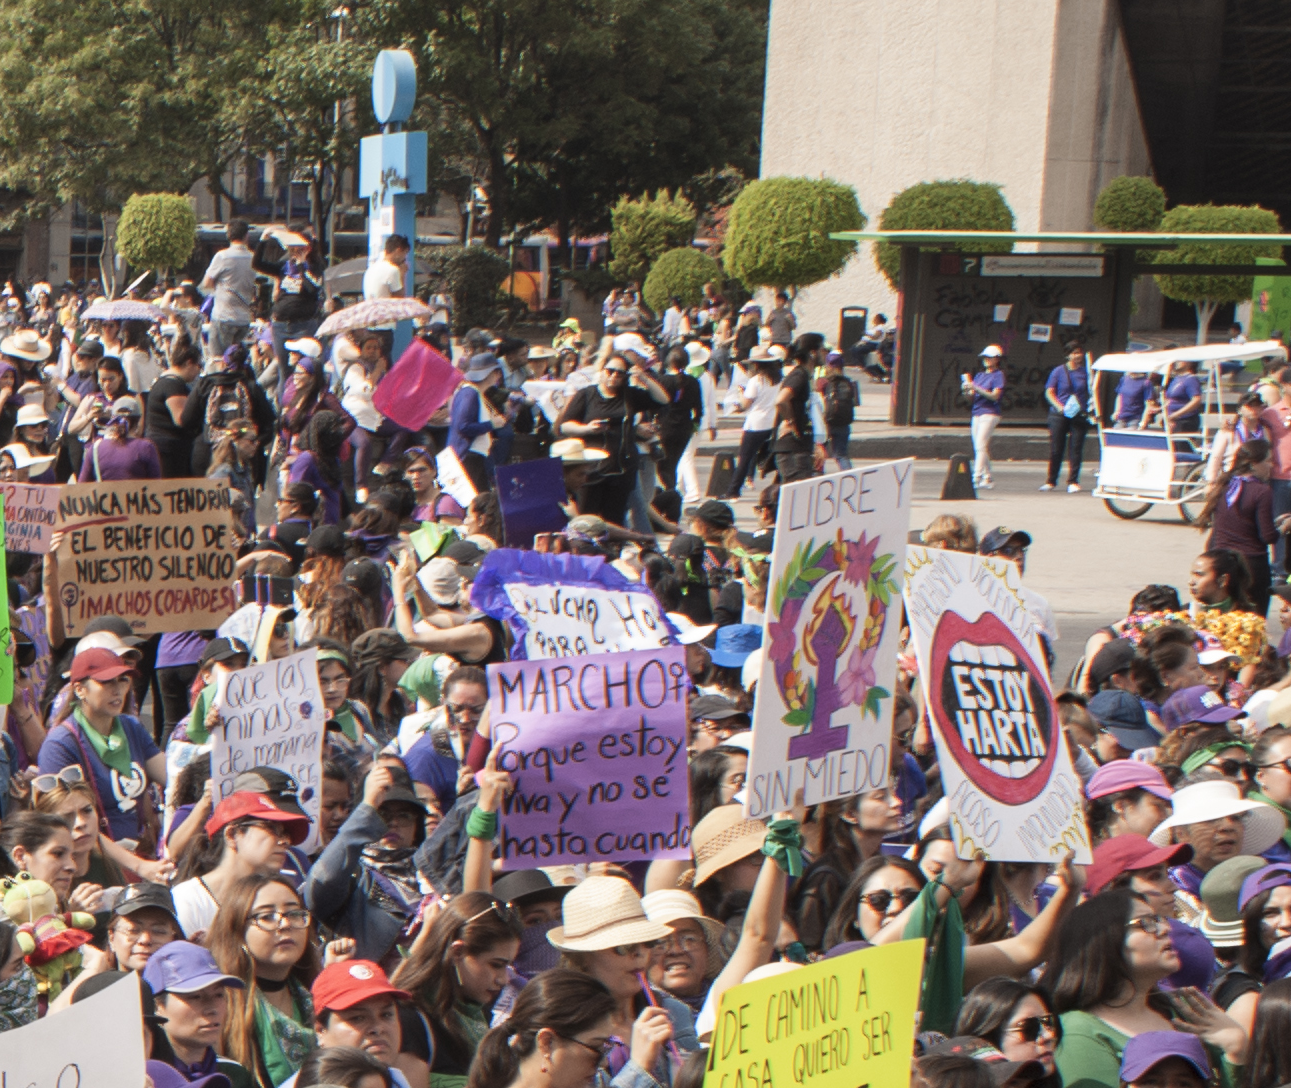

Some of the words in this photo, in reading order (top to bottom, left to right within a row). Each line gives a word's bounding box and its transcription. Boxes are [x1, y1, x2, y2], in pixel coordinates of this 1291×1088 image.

[25, 487, 46, 505] TU
[59, 491, 126, 523] NUNCA
[127, 487, 163, 516] MÁS
[789, 468, 880, 532] LIBRE
[893, 462, 913, 509] Y
[72, 530, 96, 553] EL
[104, 523, 195, 551] BENEFICIO
[203, 523, 227, 550] DE
[77, 555, 153, 583] NUESTRO
[158, 552, 235, 581] SILENCIO
[275, 657, 306, 698] las
[496, 658, 668, 715] MARCHO
[950, 663, 1037, 714] ESTOY
[221, 697, 293, 743] niñas
[955, 708, 1047, 760] HARTA
[218, 745, 248, 776] de
[253, 730, 319, 767] mañana
[493, 721, 588, 783] Porque
[597, 714, 684, 767] estoy
[557, 791, 579, 826] y
[587, 780, 623, 805] no
[631, 766, 675, 800] sé
[749, 764, 794, 819] SIN
[802, 743, 888, 807] MIEDO
[500, 823, 589, 860] hasta
[594, 811, 692, 855] cuando
[951, 778, 1001, 848] ACOSO
[765, 974, 840, 1045] CAMINO
[855, 967, 871, 1014] A
[792, 1026, 851, 1086] QUIERO
[862, 1010, 893, 1061] SER
